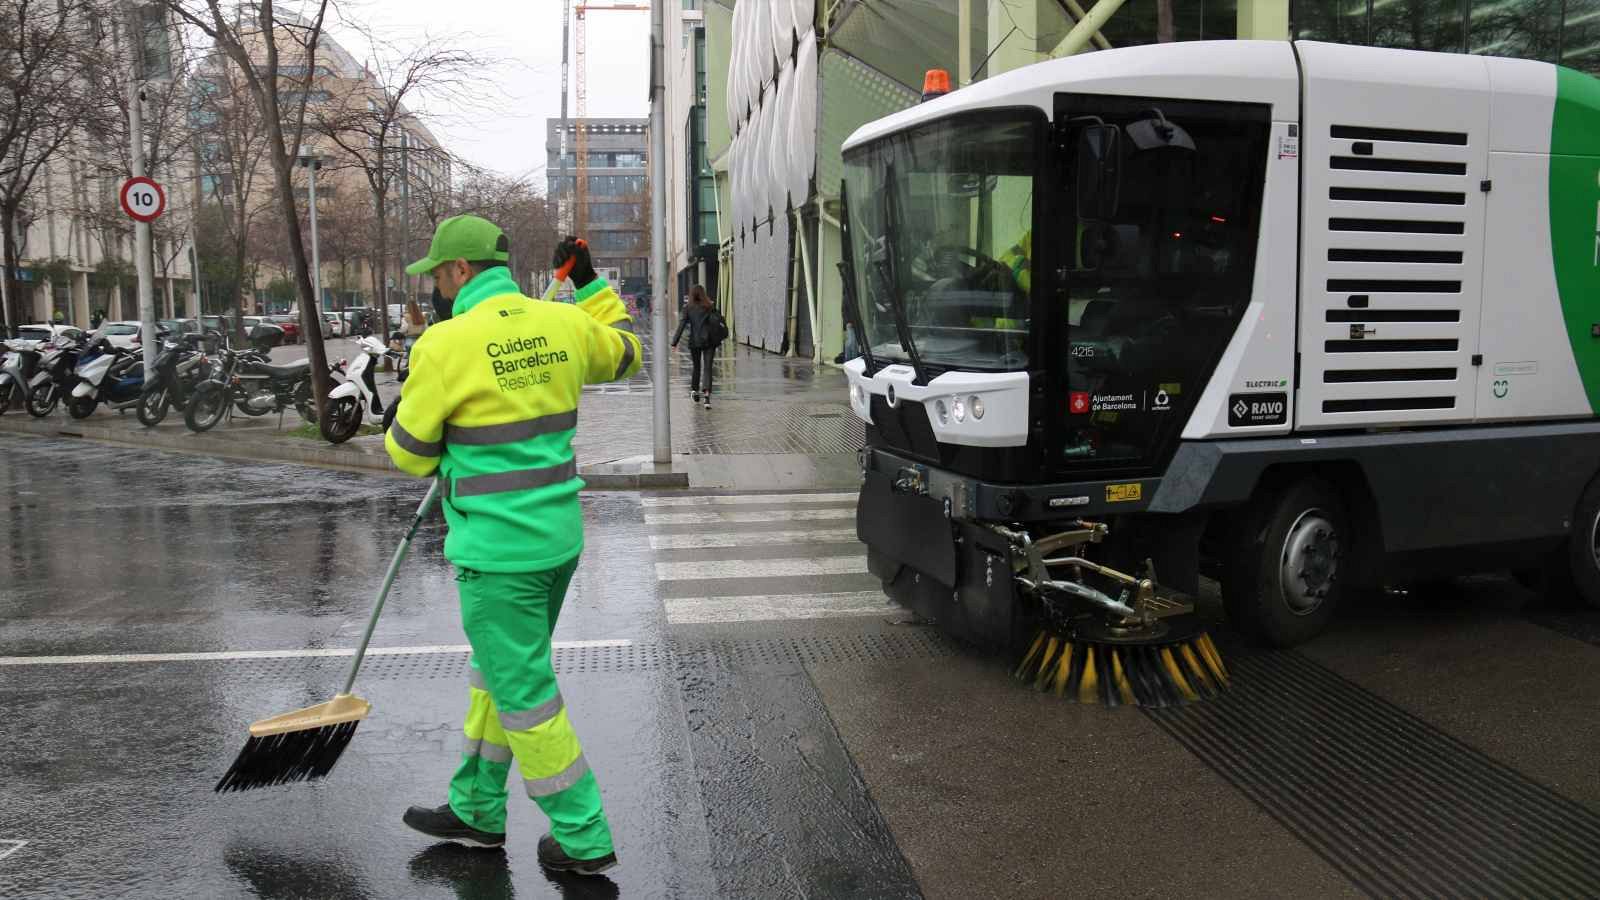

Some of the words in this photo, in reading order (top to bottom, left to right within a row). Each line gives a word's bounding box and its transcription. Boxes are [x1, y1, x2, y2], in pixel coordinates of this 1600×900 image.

[133, 192, 153, 206] 10
[486, 336, 548, 358] Cuidem
[1071, 346, 1094, 358] 4215
[492, 350, 569, 376] Barcelona
[497, 371, 552, 393] Residus
[1092, 394, 1133, 404] Ajuntament
[1102, 402, 1136, 410] Barcelona
[1251, 402, 1283, 414] RAVO
